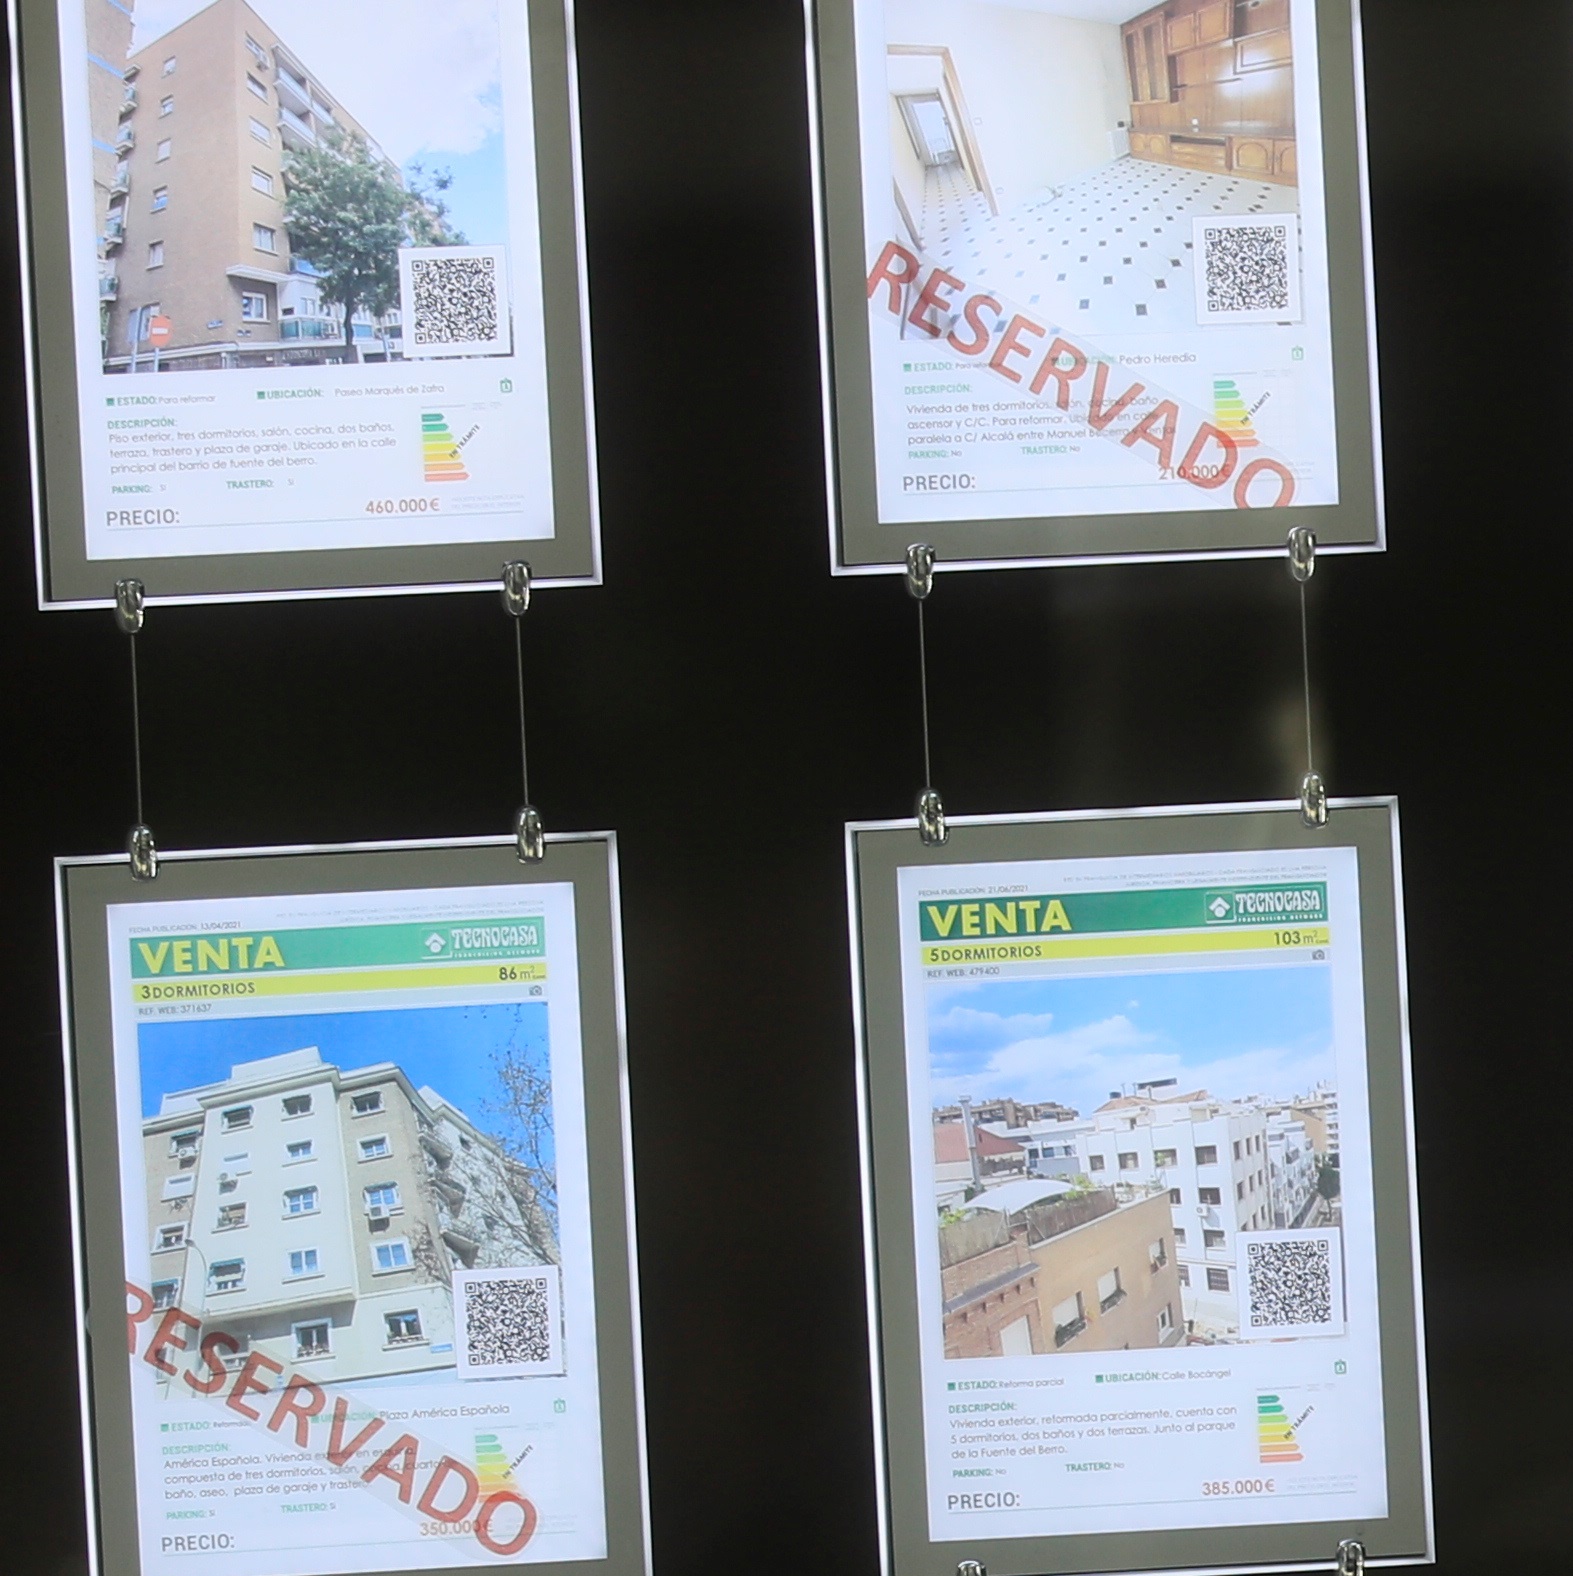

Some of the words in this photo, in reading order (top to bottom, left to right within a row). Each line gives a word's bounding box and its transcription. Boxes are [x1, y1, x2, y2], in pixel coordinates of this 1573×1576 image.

[1120, 354, 1153, 366] Pedro
[1152, 352, 1197, 363] Heredia
[868, 240, 1295, 509] RESERVADO
[903, 474, 976, 490] PRECIO:
[106, 508, 181, 525] PRECIO:
[1236, 888, 1322, 913] TECNOCASA
[927, 898, 1073, 938] VENTA
[451, 925, 539, 952] TECNOCASA
[1274, 928, 1303, 948] 103
[139, 935, 285, 976] VENTA
[499, 966, 518, 982] 86
[125, 1281, 537, 1556] RESERVADO
[948, 1492, 1021, 1509] PRECIO:
[161, 1534, 236, 1551] PRECIO:
